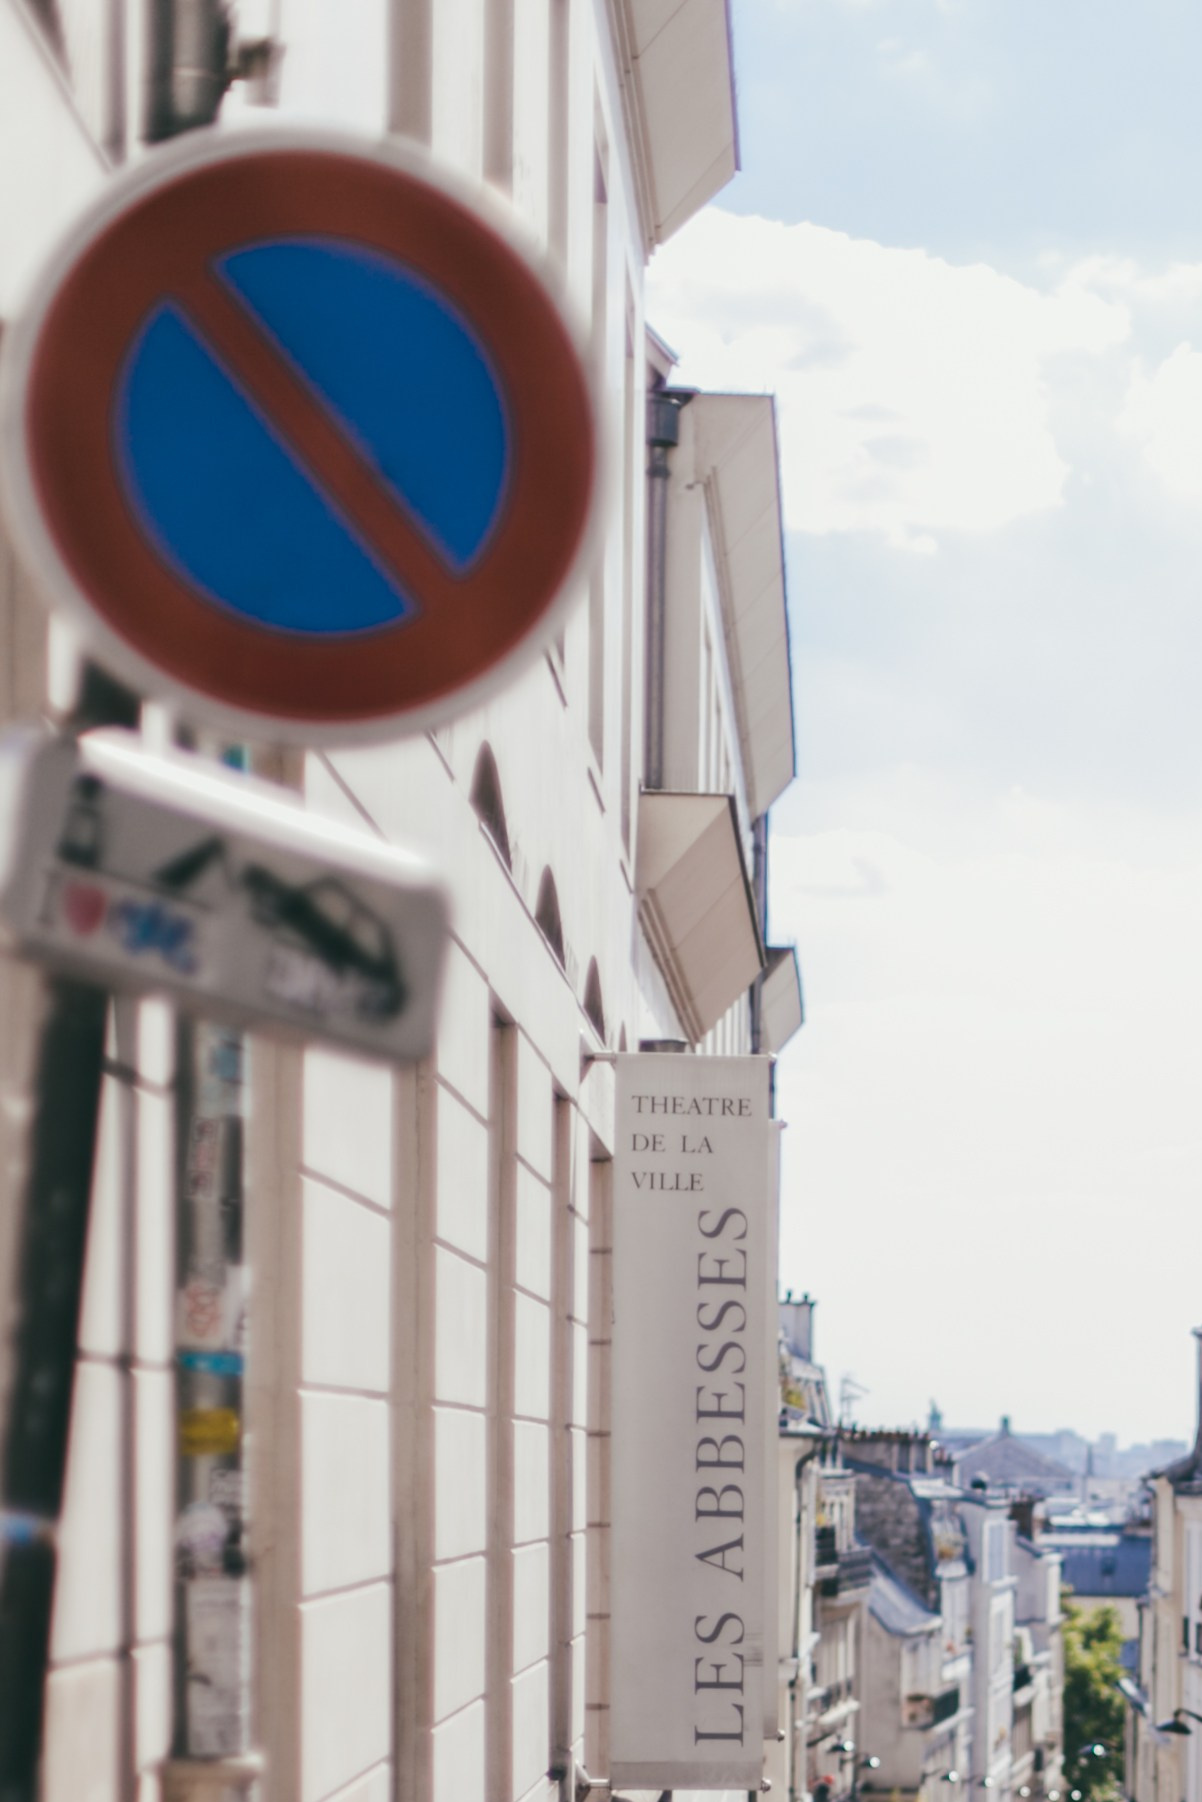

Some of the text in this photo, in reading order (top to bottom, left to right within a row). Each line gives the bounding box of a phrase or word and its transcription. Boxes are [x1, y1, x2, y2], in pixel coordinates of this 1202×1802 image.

[631, 1095, 752, 1117] THEATRE
[631, 1133, 714, 1155] DE LA
[631, 1171, 704, 1192] VILLE
[693, 1206, 748, 1749] LES ABBESSES
